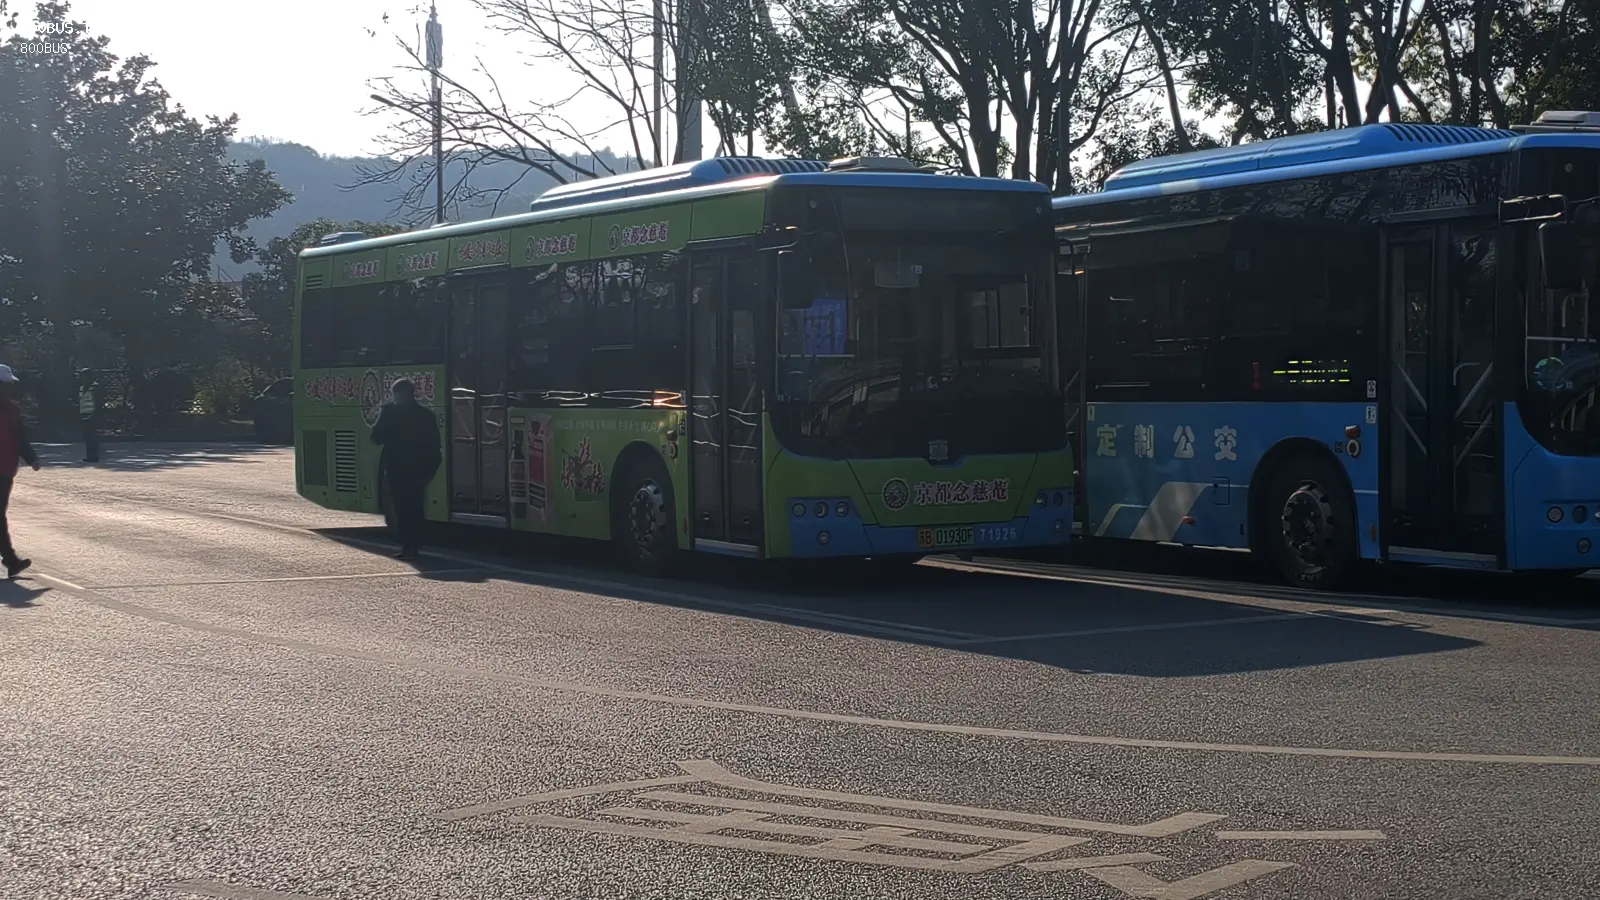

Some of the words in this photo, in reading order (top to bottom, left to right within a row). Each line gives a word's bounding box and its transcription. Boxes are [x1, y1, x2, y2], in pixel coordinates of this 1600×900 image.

[1095, 423, 1238, 462] 定制公交
[979, 527, 1017, 541] 71926
